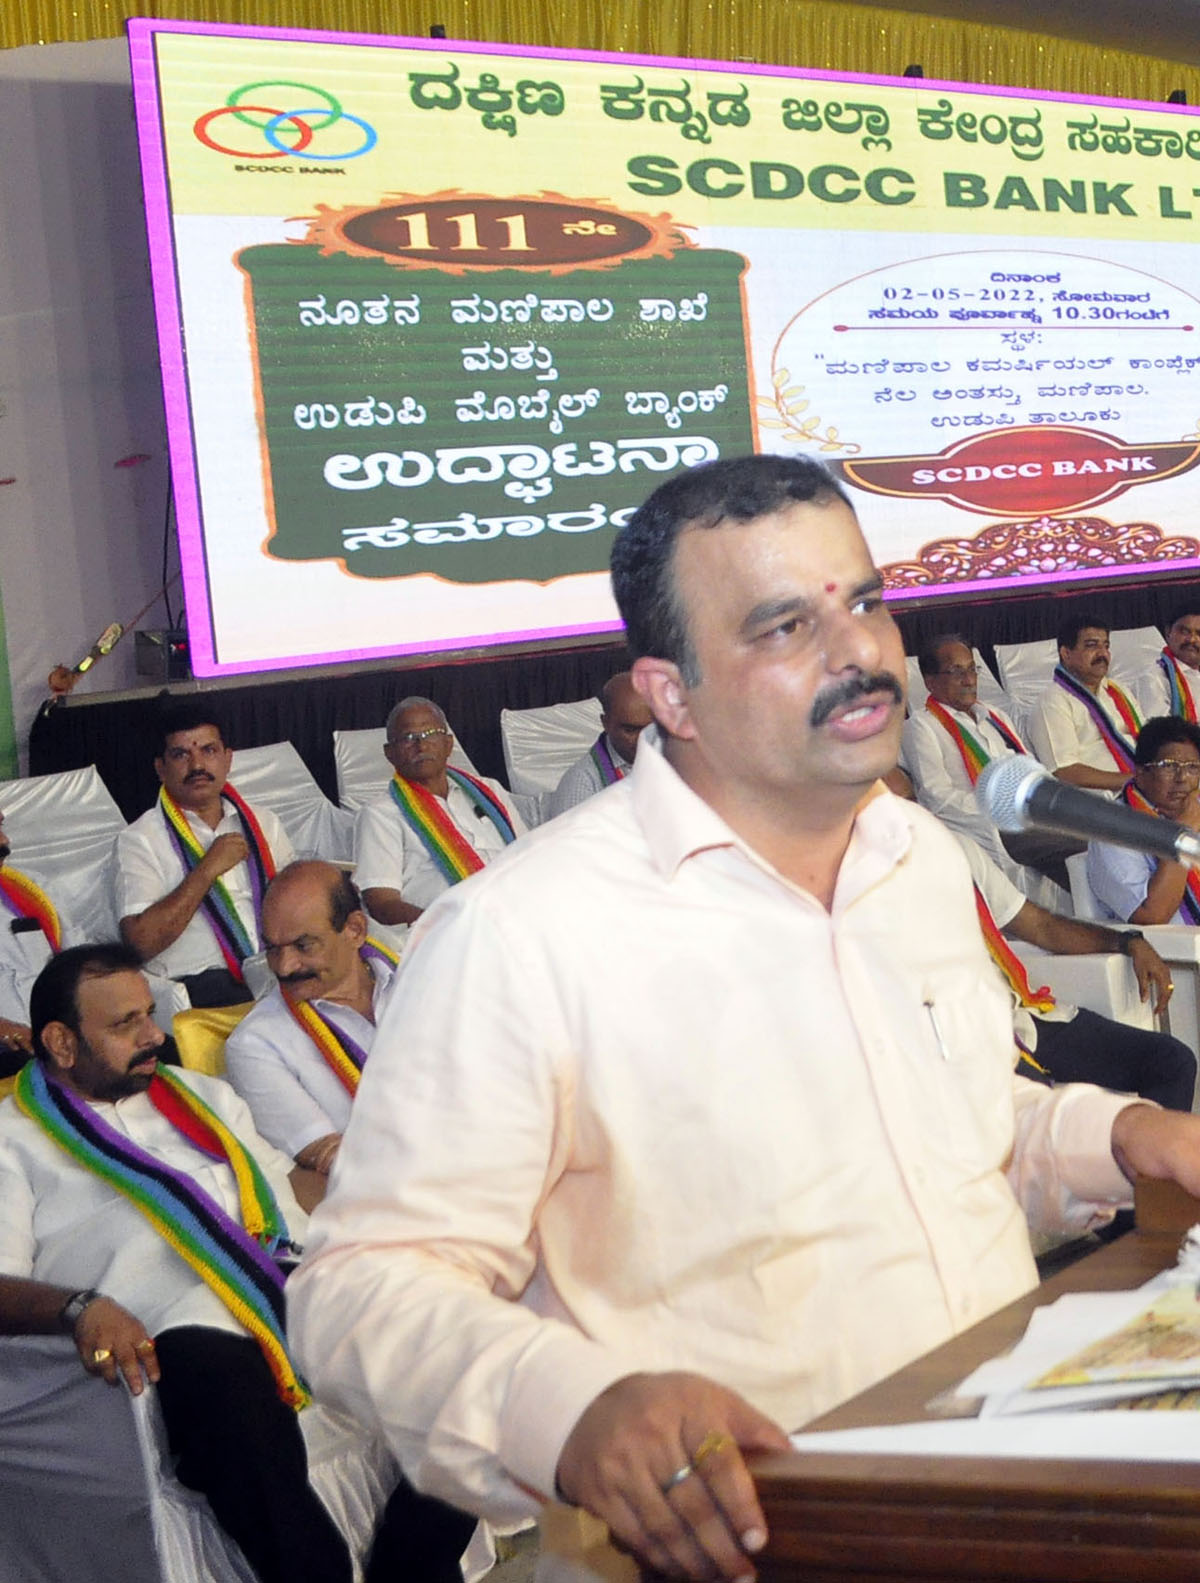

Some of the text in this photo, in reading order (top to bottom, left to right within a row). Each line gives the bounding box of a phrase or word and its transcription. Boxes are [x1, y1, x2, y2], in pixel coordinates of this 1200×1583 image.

[408, 62, 565, 137] ದಕ್ಷಿಣ
[600, 75, 751, 144] ಕನ್ನಡ
[781, 97, 893, 152] ಜಿಲ್ಲಾ
[917, 100, 1045, 162] ಕೇಂದ್ರ
[234, 164, 346, 174] SCDCC BANK
[627, 155, 917, 206] SCDCC
[942, 171, 1138, 217] BANK
[397, 212, 618, 251] 111 ನೇ
[990, 272, 1061, 284] ದಿನಾಂಕ
[883, 286, 1151, 303] 02-05-2022, ಸೋಮವಾರ
[299, 292, 711, 327] ನೂತನ ಮಣಿಪಾಲ ಶಾಖೆ
[868, 307, 940, 320] ಸಮಯ
[461, 341, 558, 381] ಮತ್ತು
[966, 356, 1114, 373] ಕಮರ್ಷಿಯಲ್
[873, 388, 917, 404] ನೆಲ
[1037, 382, 1149, 398] ಮಣಿಪಾಲ.
[293, 384, 730, 434] ಉಡುಪಿ ಮೊಬೈಲ್ ಬ್ಯಾಂಕ್
[930, 408, 1121, 429] ಉಡುಪಿ ತಾಲೂಕು
[323, 435, 721, 504] ಉದ್ಘಾಟನಾ
[912, 456, 1157, 485] SCDCC BANK
